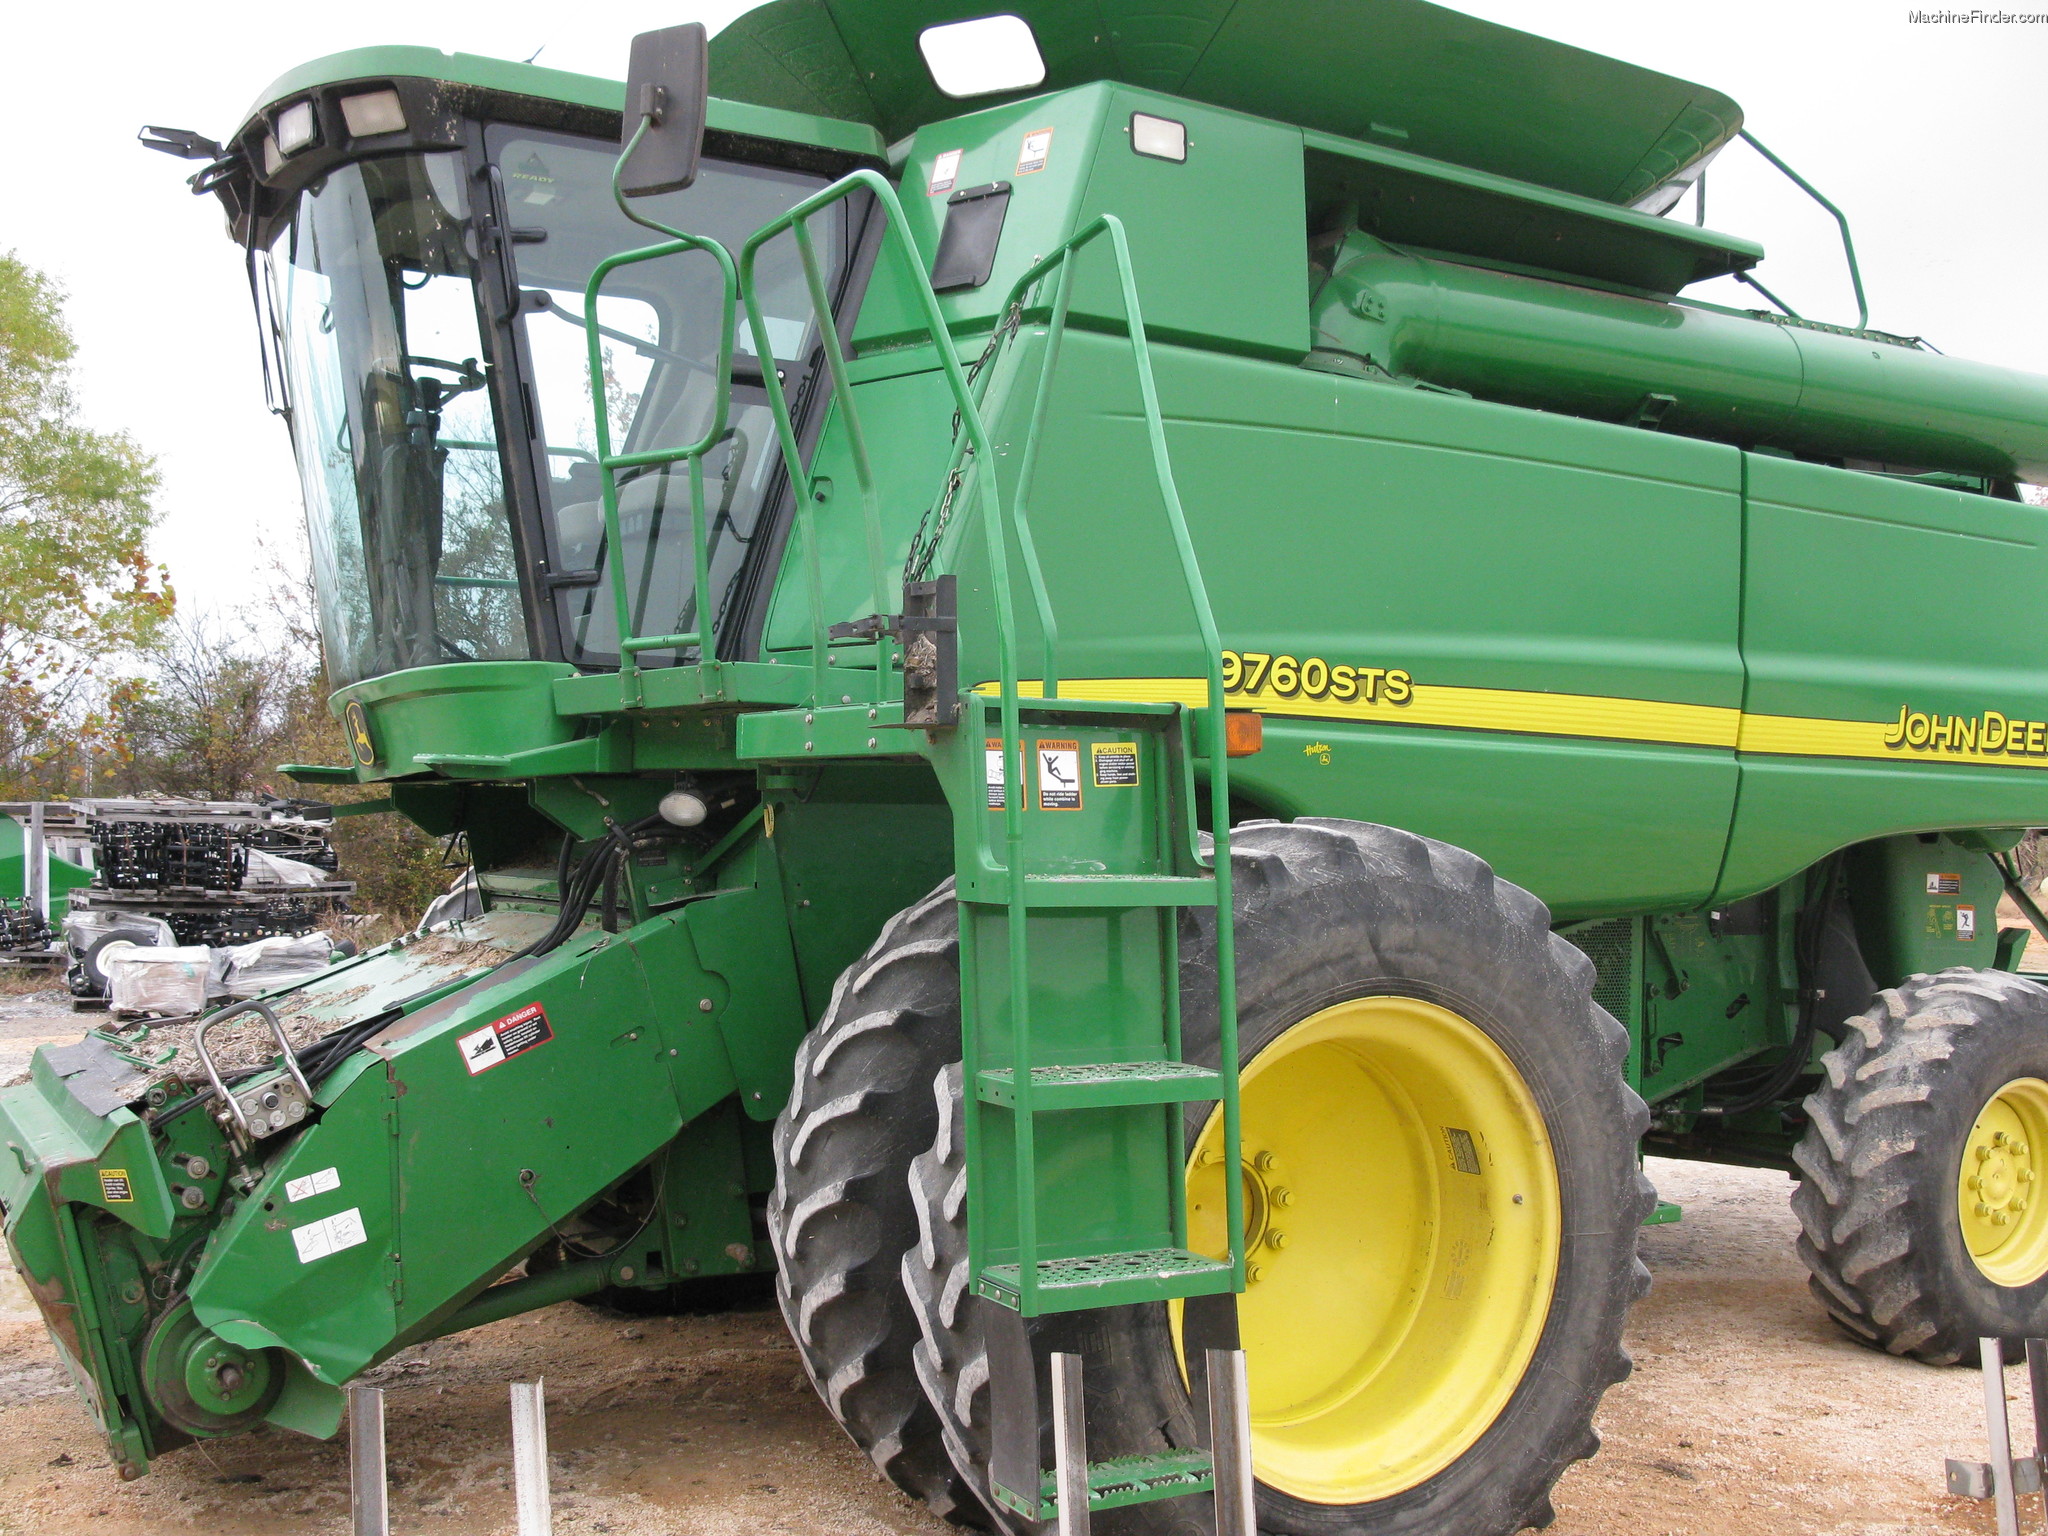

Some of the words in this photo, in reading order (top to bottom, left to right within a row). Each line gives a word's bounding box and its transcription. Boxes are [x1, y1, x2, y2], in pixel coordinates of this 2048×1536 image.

[1221, 650, 1414, 708] 9760STS
[1045, 741, 1077, 750] WARNING
[1102, 746, 1133, 754] CAUTION
[506, 1006, 537, 1025] DANGER
